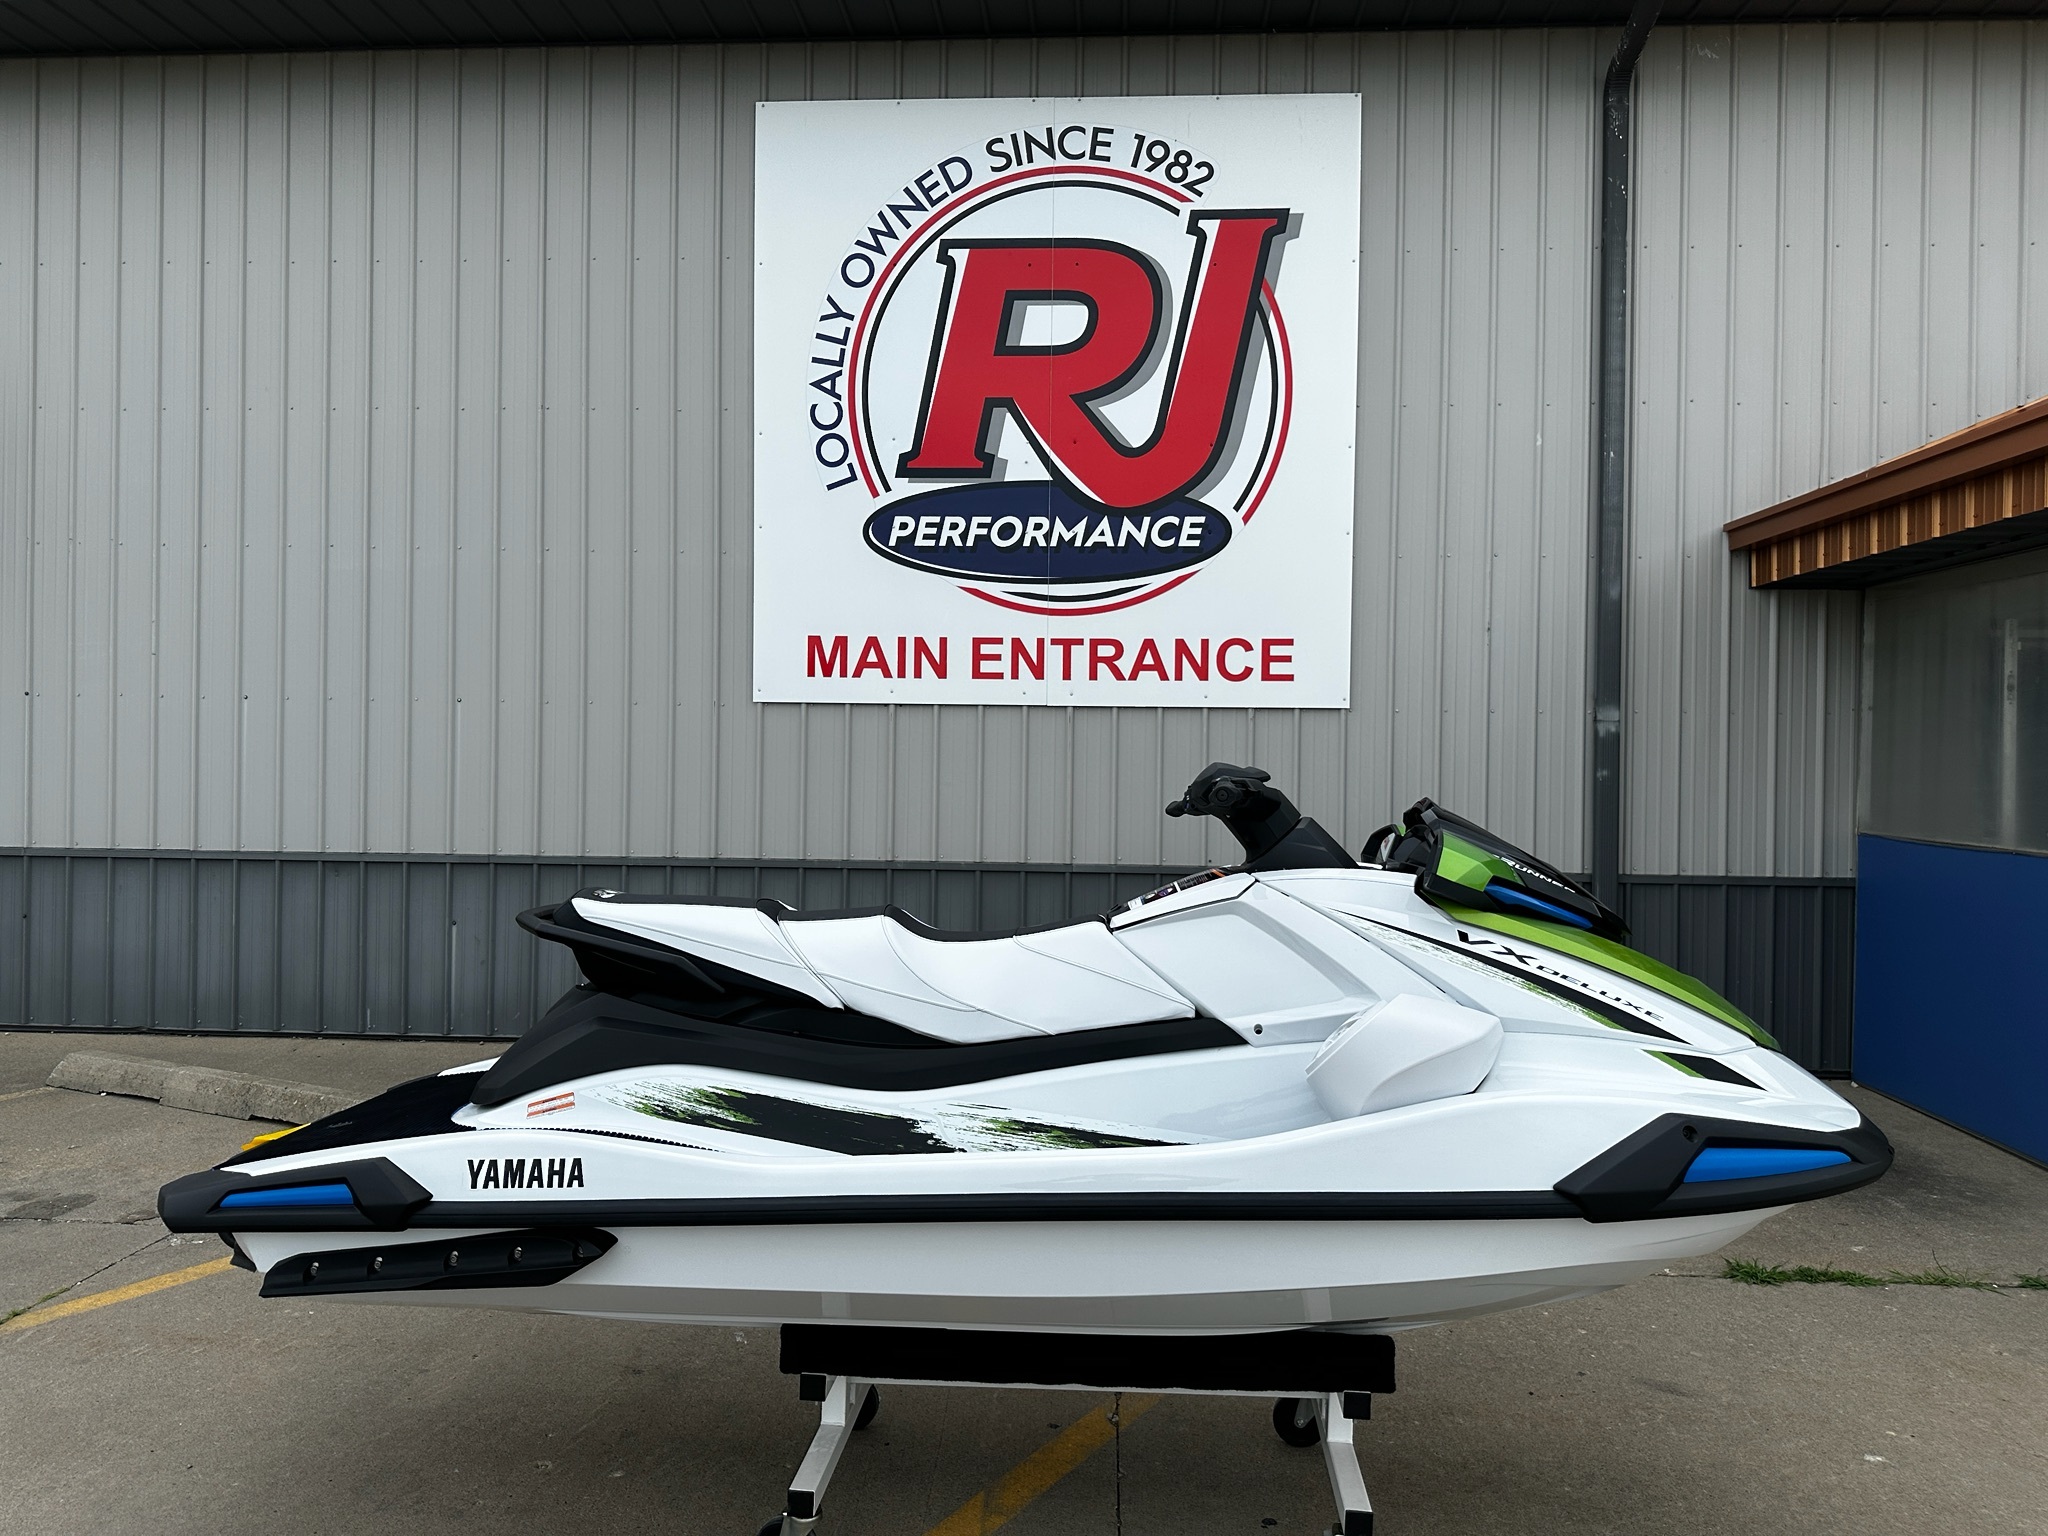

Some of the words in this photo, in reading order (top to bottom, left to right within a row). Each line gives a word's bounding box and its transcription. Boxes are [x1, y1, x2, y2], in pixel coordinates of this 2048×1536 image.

[809, 294, 859, 491] LOCALLY
[840, 156, 974, 289] OWNED
[985, 125, 1115, 173] SINCE
[1129, 133, 1216, 198] 1982
[895, 208, 1291, 512] RJ
[888, 515, 1204, 548] PERFORMANCE
[806, 635, 948, 679] MAIN
[971, 637, 1296, 683] ENTRANCE
[1456, 929, 1539, 966] VX
[1536, 964, 1665, 1022] DELUXE
[467, 1157, 585, 1189] YAMAHA
